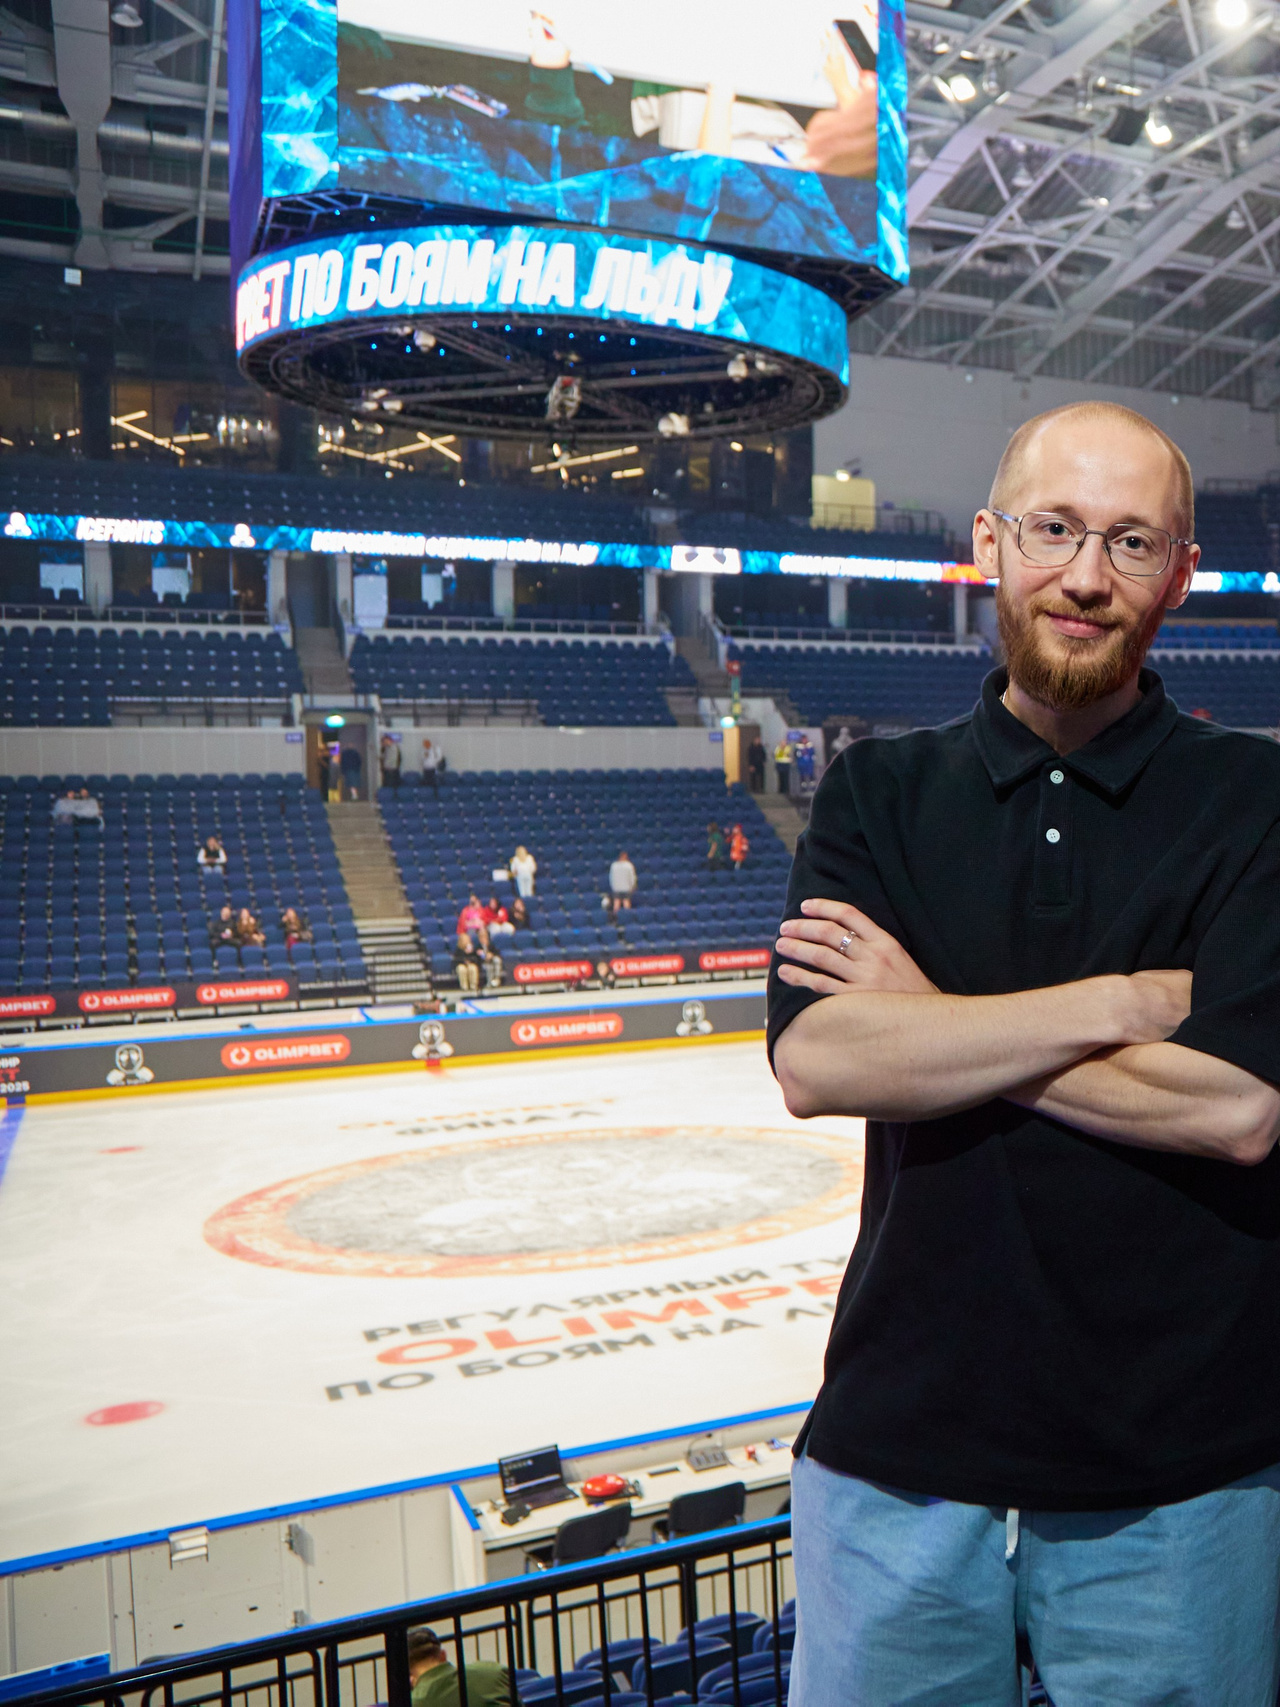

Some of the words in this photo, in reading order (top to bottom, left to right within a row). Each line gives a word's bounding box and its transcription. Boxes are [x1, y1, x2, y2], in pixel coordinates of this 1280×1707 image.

[289, 249, 344, 322] ПО
[346, 239, 495, 311] БОЯМ
[499, 240, 575, 307] НА
[581, 246, 734, 330] ЛЬДУ
[102, 992, 170, 1006] OLIMPBET
[219, 984, 283, 999] OLIMPBET
[0, 1000, 50, 1013] MPBET
[540, 1020, 618, 1038] OLIMPBET
[254, 1042, 344, 1061] OLIMPBET
[362, 1267, 771, 1343] РЕГУЛЯРНЫЙ
[325, 1371, 436, 1402] ПО
[457, 1333, 656, 1379] БОЯМ
[669, 1318, 765, 1341] НА
